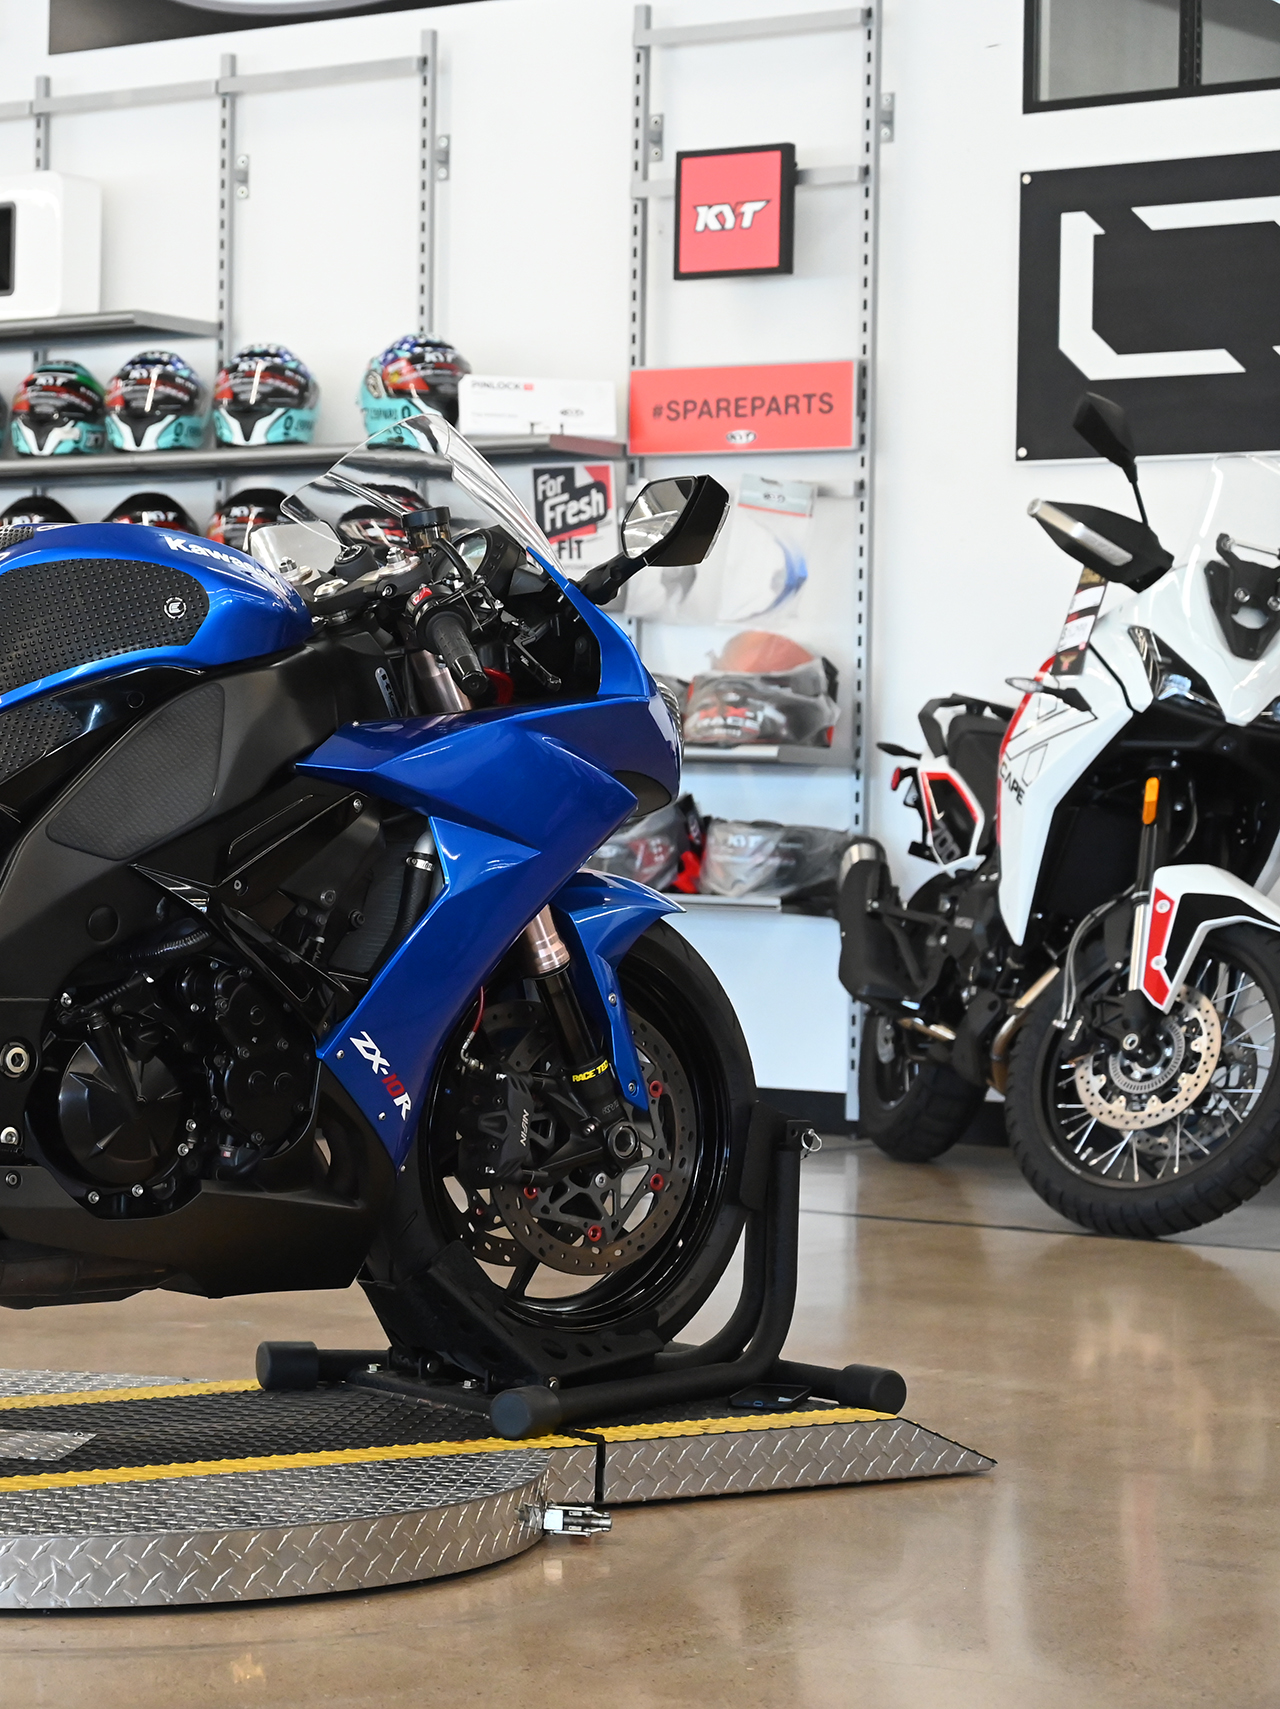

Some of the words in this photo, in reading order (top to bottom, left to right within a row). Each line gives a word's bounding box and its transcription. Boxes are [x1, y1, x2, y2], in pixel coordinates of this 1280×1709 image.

[693, 199, 771, 233] KYT
[652, 392, 834, 422] #SPAREPARTS
[536, 473, 566, 501] For
[544, 488, 605, 532] Fresh
[557, 537, 583, 559] FIT
[1000, 762, 1026, 806] CAPE
[349, 1030, 412, 1121] ZX-10R
[572, 1068, 597, 1083] RACE
